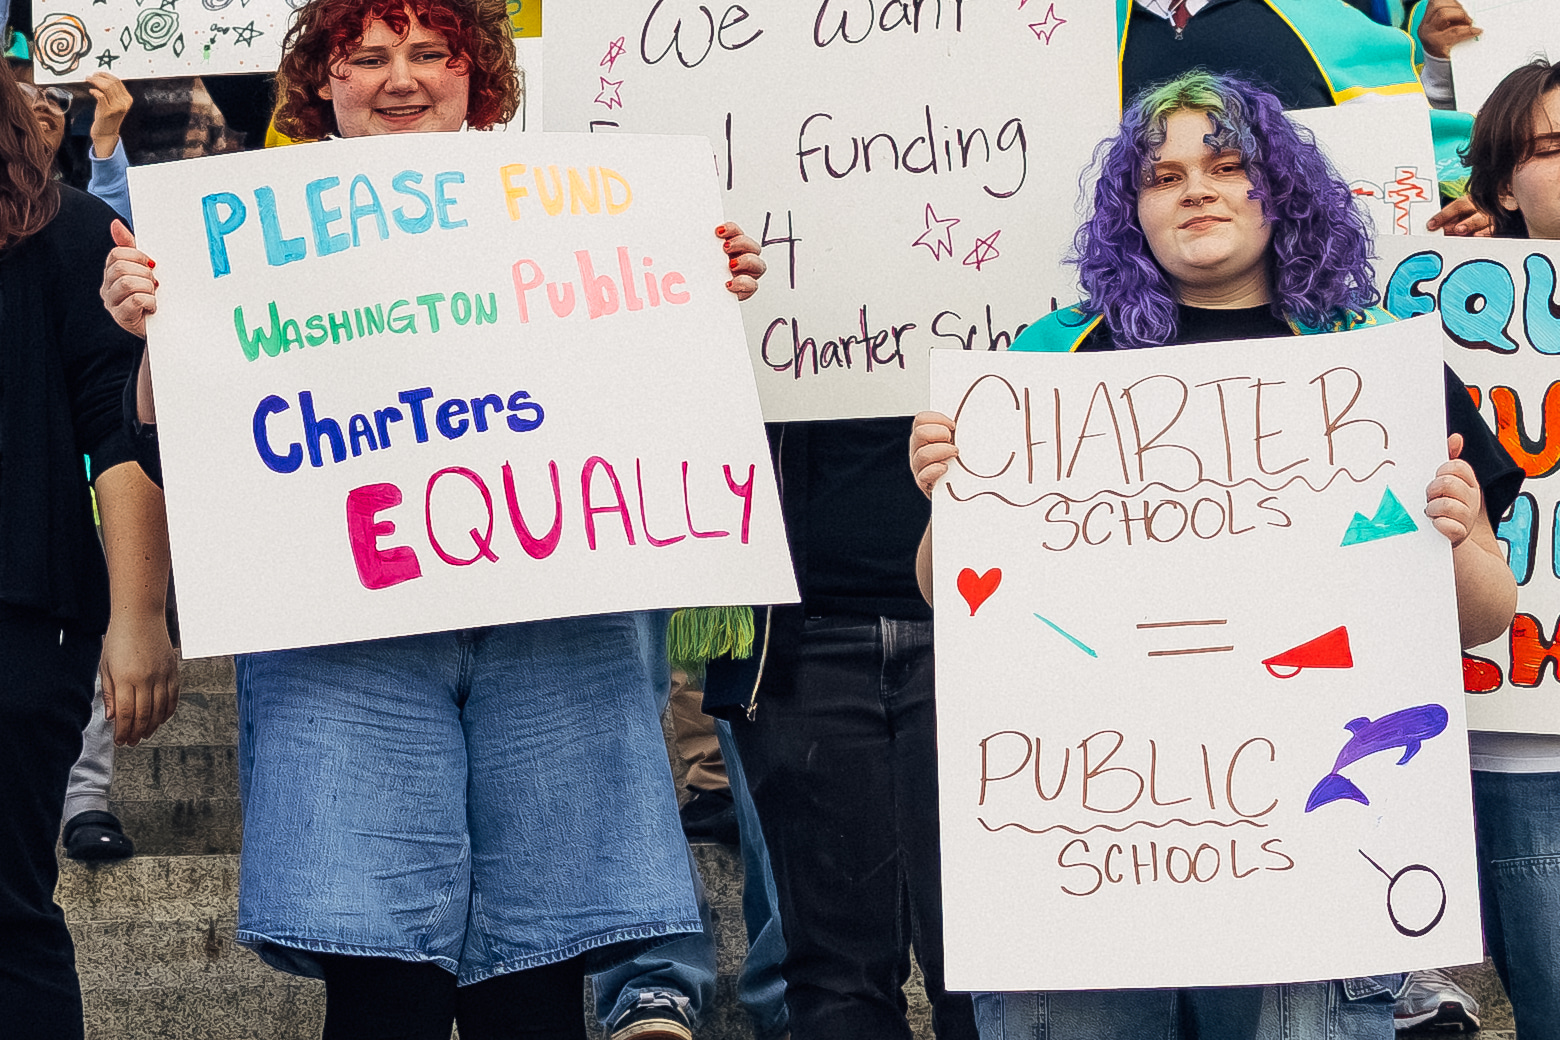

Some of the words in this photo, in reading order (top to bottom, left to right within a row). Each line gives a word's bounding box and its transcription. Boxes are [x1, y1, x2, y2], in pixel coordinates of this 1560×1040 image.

[796, 104, 1029, 198] funding
[200, 169, 468, 279] PLEASE
[499, 162, 633, 221] FUND
[760, 210, 802, 290] 4
[233, 289, 498, 362] WASHINGTON
[511, 246, 691, 324] Public
[760, 304, 917, 380] Charter
[953, 366, 1389, 484] CHARTER
[347, 455, 756, 590] EQUALLY
[1042, 489, 1293, 552] SCHOOLS
[979, 730, 1279, 818] PUBLIC
[1057, 838, 1295, 896] SCHOOLS
